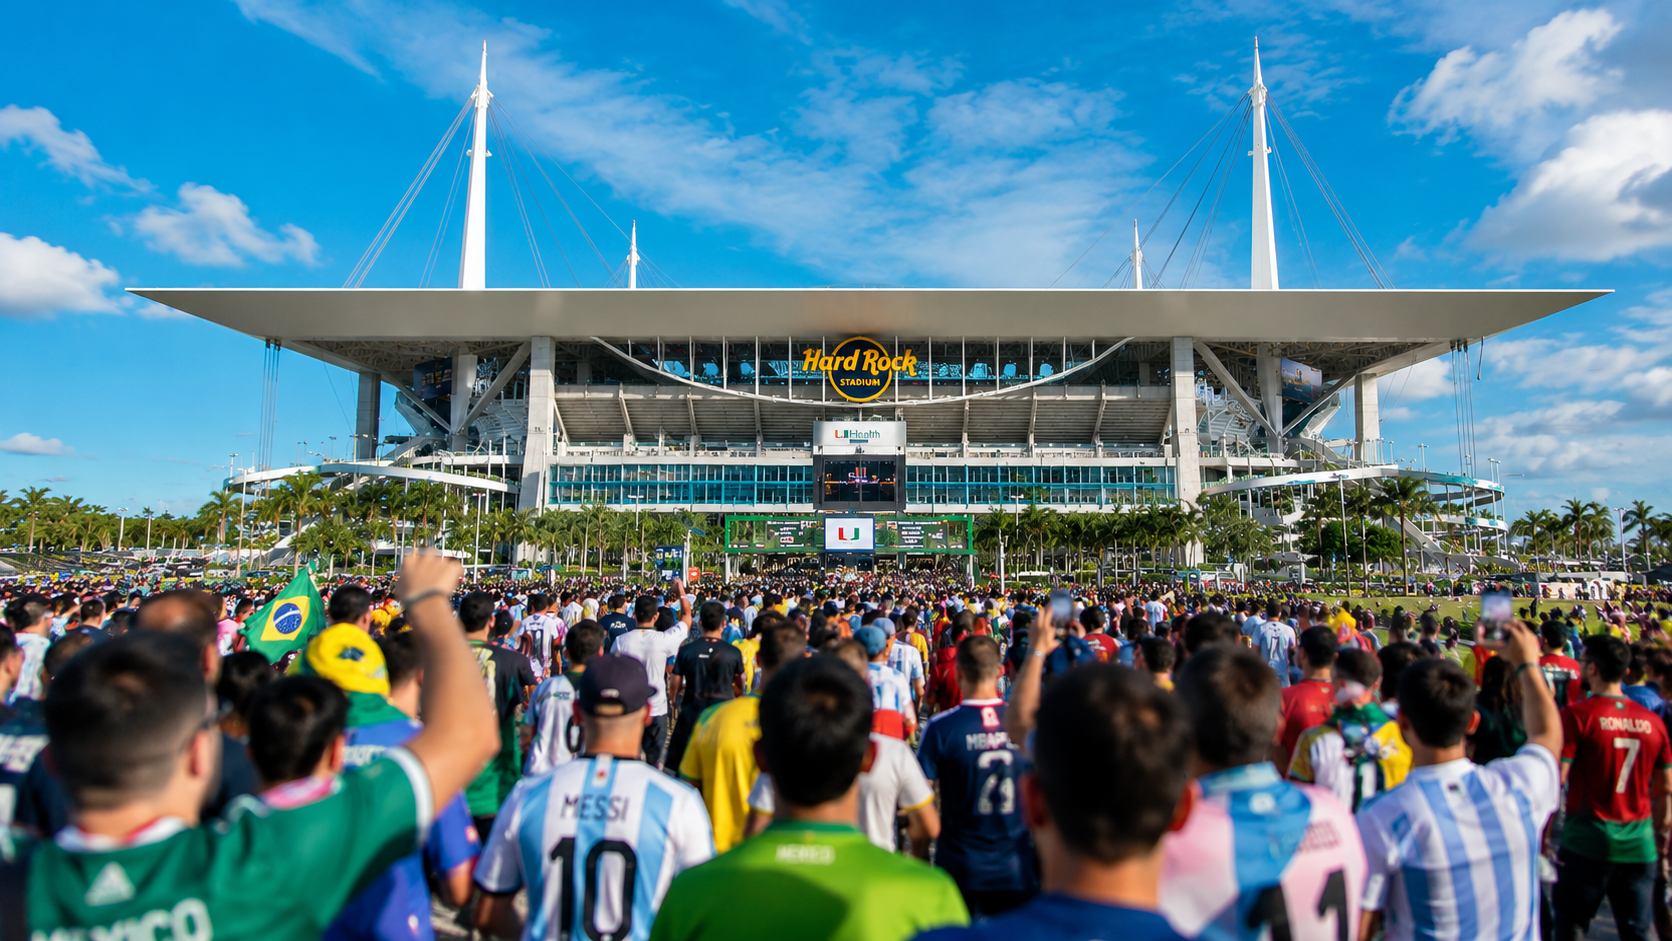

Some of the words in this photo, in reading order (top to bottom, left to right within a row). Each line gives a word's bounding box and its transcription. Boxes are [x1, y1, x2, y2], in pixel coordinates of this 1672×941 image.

[802, 348, 860, 371] Hard
[862, 348, 917, 377] Rock
[838, 527, 860, 541] U
[1599, 716, 1652, 734] RONALDO
[1614, 737, 1640, 794] 7
[560, 793, 630, 822] MESSI
[551, 837, 637, 941] 10
